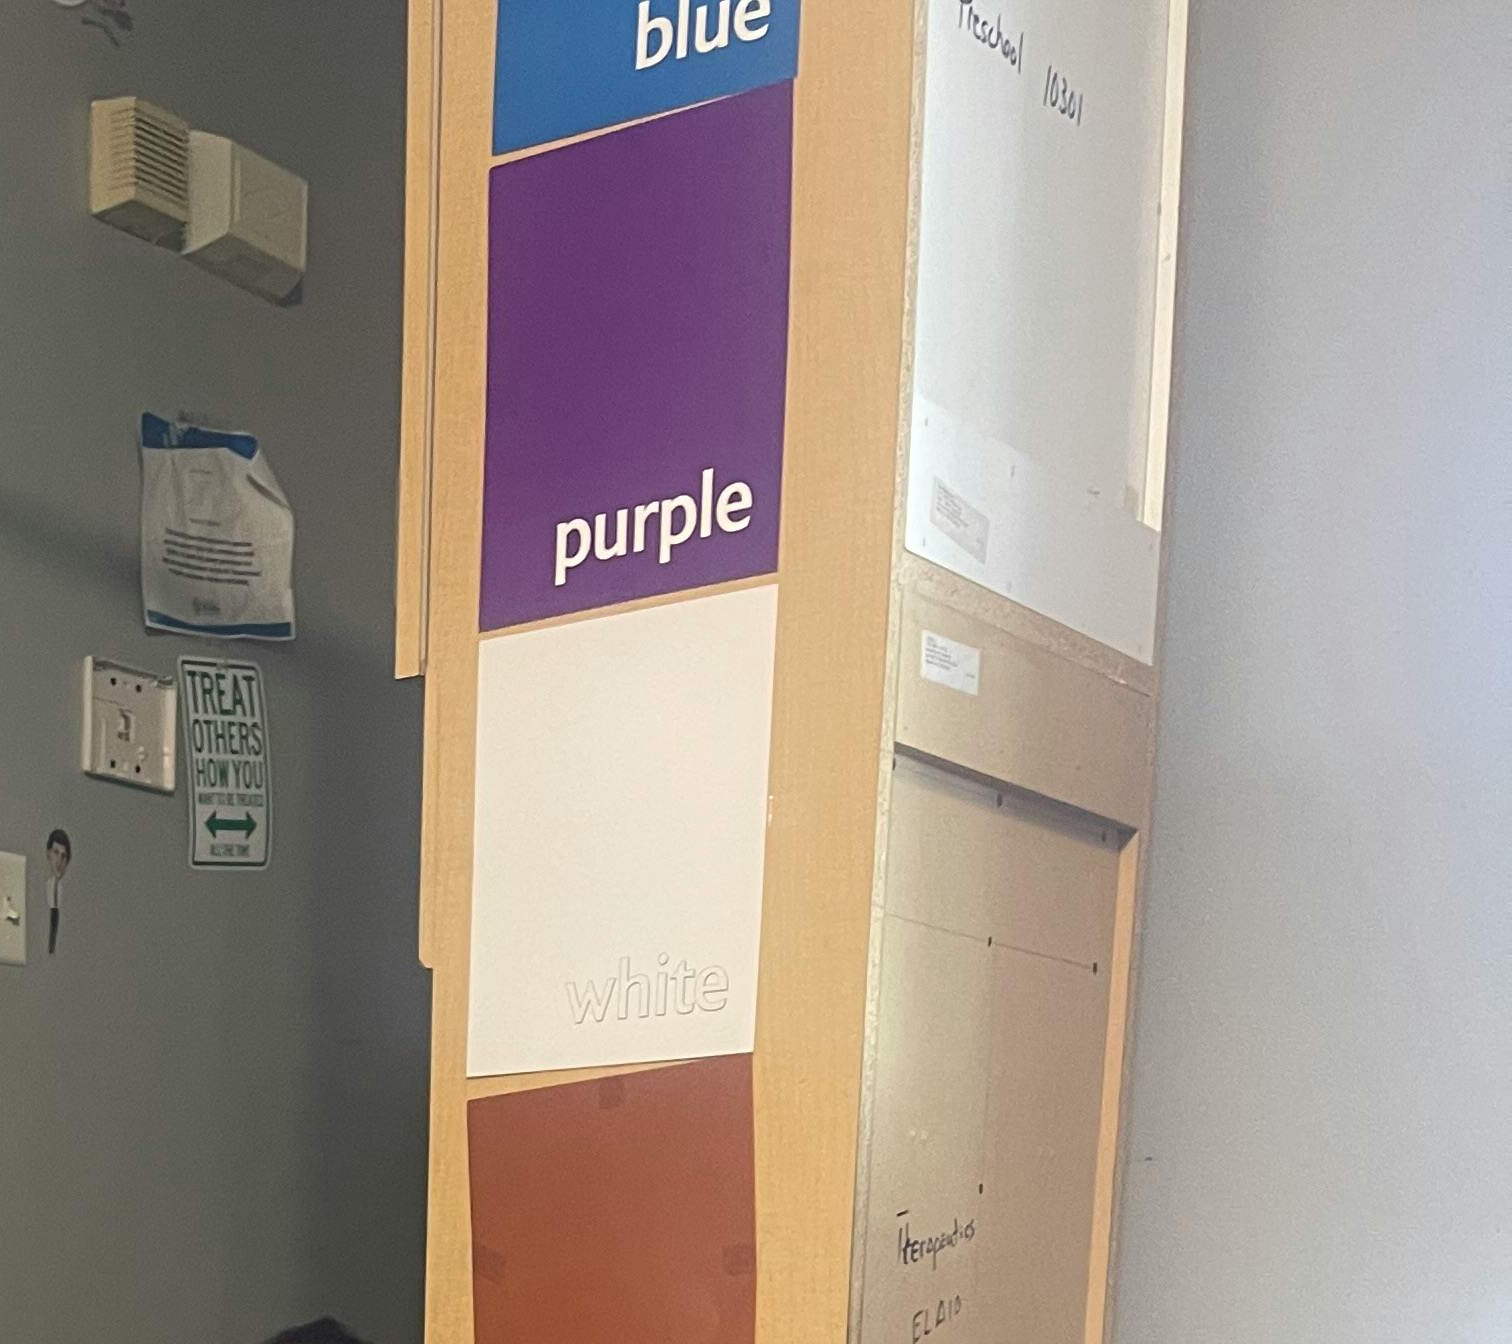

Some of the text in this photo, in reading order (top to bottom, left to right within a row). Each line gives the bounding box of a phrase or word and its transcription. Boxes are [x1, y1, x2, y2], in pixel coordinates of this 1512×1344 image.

[635, 0, 771, 70] blue
[1043, 65, 1084, 126] 10301
[553, 468, 753, 586] purple
[187, 670, 256, 717] TREAT
[192, 718, 263, 756] OTHERS
[196, 758, 263, 789] HOW YOU
[565, 951, 730, 1025] white
